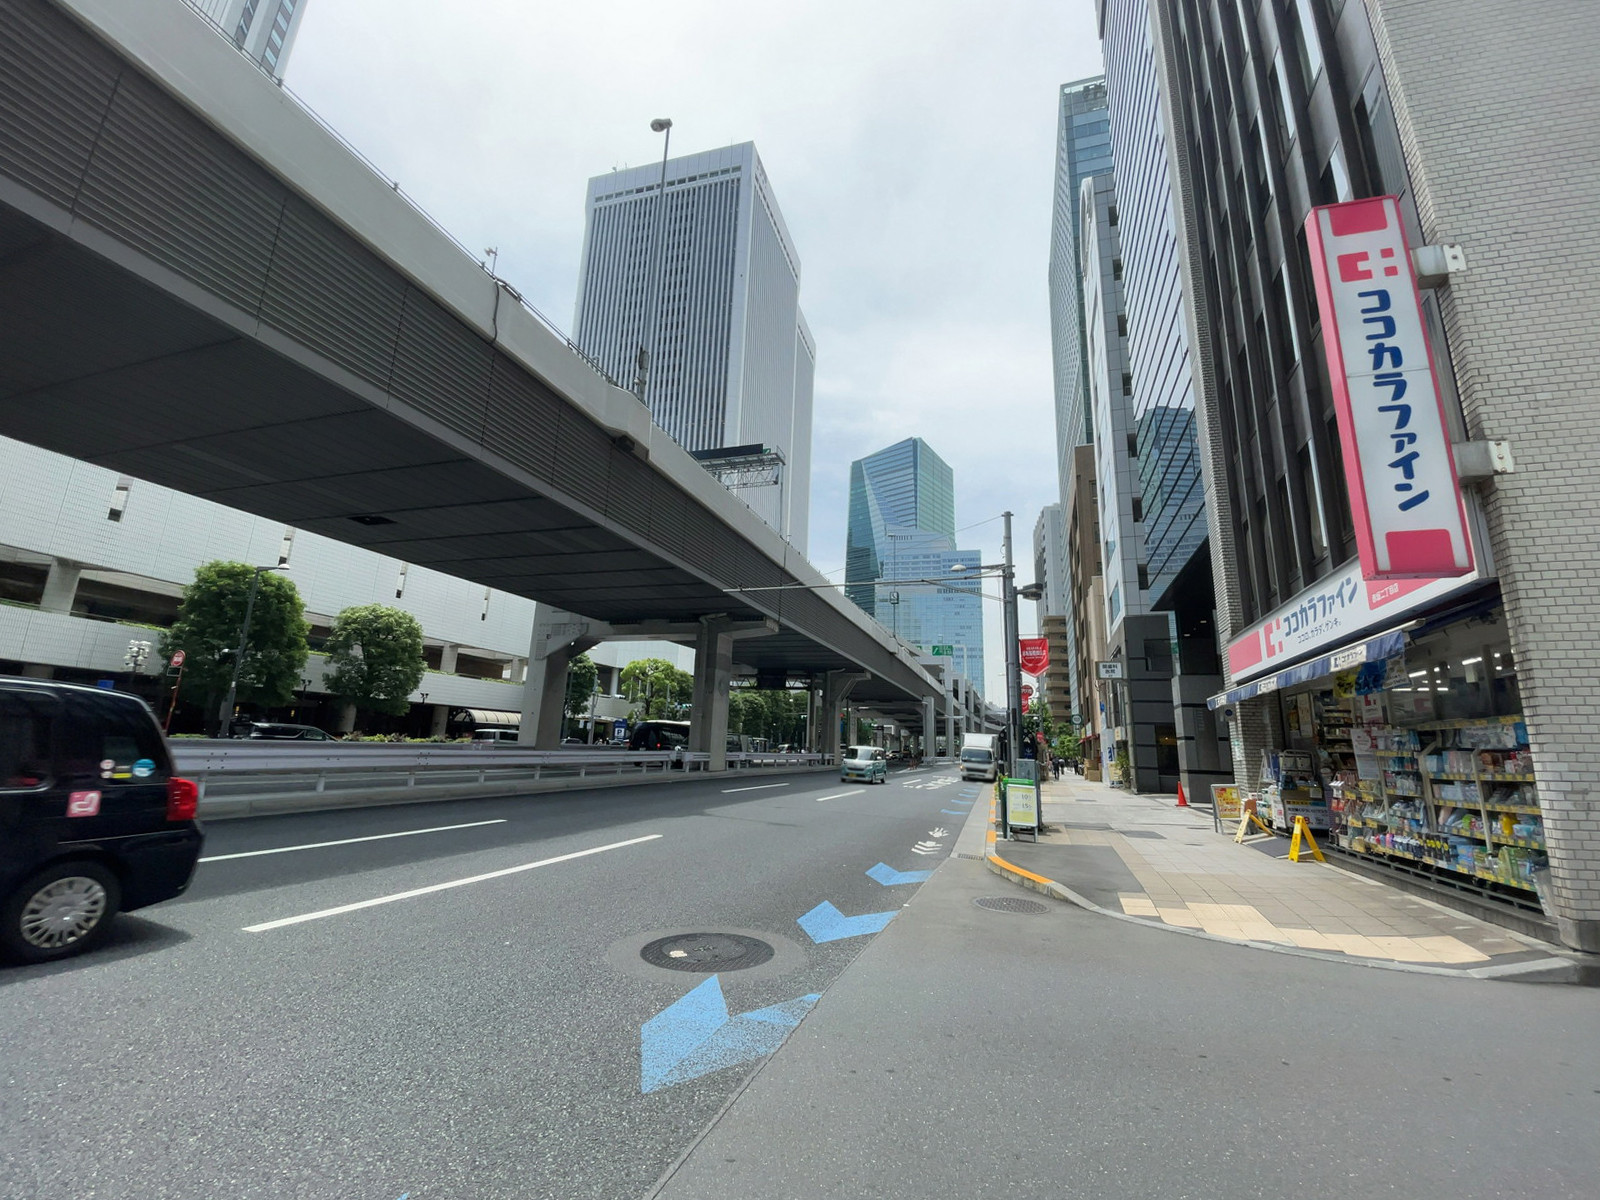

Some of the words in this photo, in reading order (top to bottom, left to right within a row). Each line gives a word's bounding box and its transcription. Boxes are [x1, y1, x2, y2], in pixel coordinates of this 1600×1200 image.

[1357, 288, 1429, 511] ココカラファイン
[1283, 577, 1358, 637] ココカラファイン
